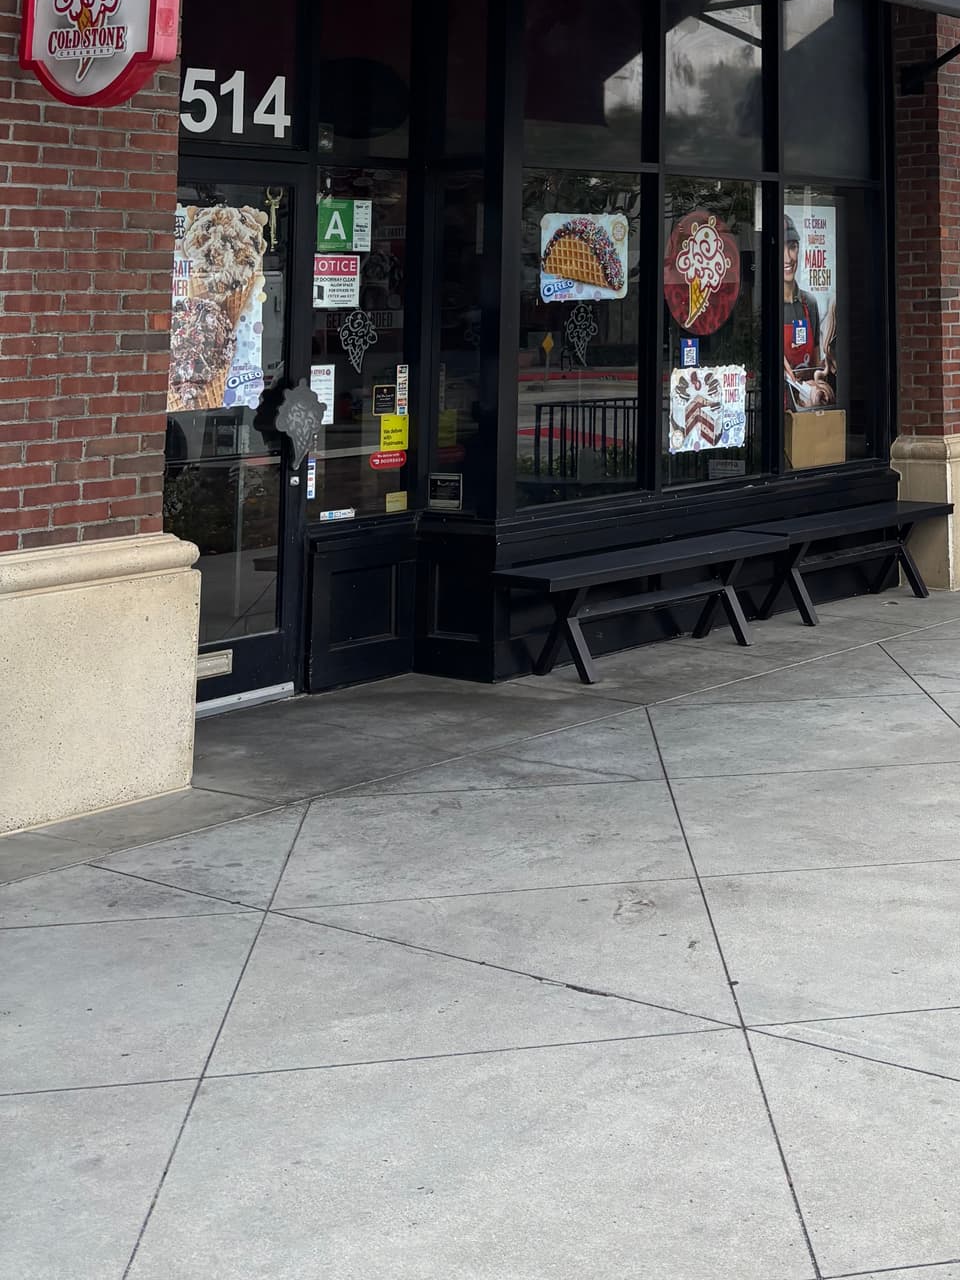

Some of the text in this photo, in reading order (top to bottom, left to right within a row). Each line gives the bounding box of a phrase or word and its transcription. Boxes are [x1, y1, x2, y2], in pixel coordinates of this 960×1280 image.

[48, 26, 126, 55] COLD STONE
[180, 67, 291, 139] 514
[324, 210, 347, 240] A
[805, 249, 827, 269] MADE
[809, 268, 832, 287] FRESH
[543, 280, 574, 297] OREO
[227, 370, 262, 389] OREO
